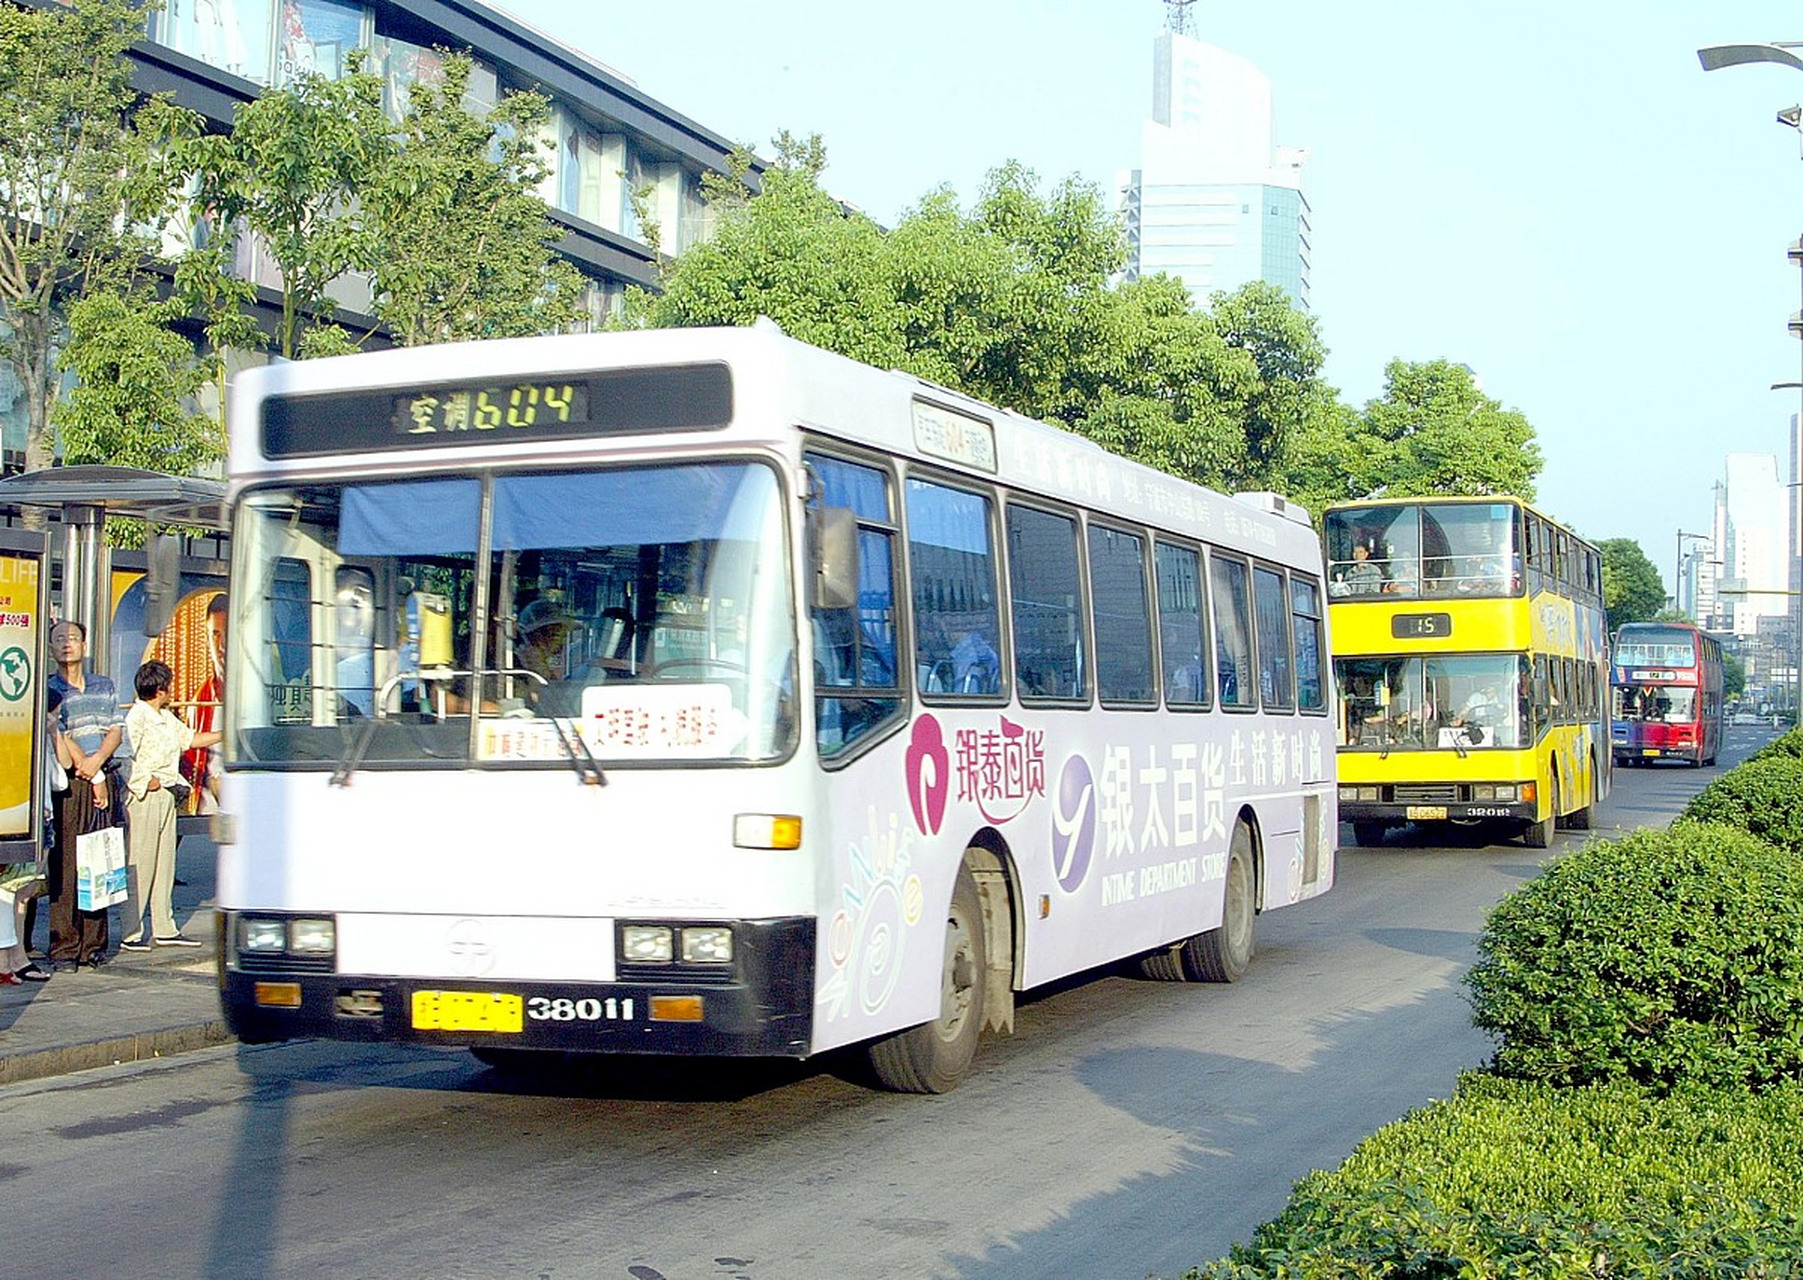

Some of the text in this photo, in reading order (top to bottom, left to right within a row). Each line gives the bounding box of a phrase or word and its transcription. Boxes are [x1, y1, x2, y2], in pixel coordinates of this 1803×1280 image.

[1417, 616, 1435, 634] 15
[954, 714, 1046, 806] 银泰百货
[1100, 742, 1227, 860] 银太百货
[1229, 728, 1322, 786] 生活新时尚
[1139, 856, 1198, 898] DEPARTMENT
[527, 996, 635, 1022] 38011
